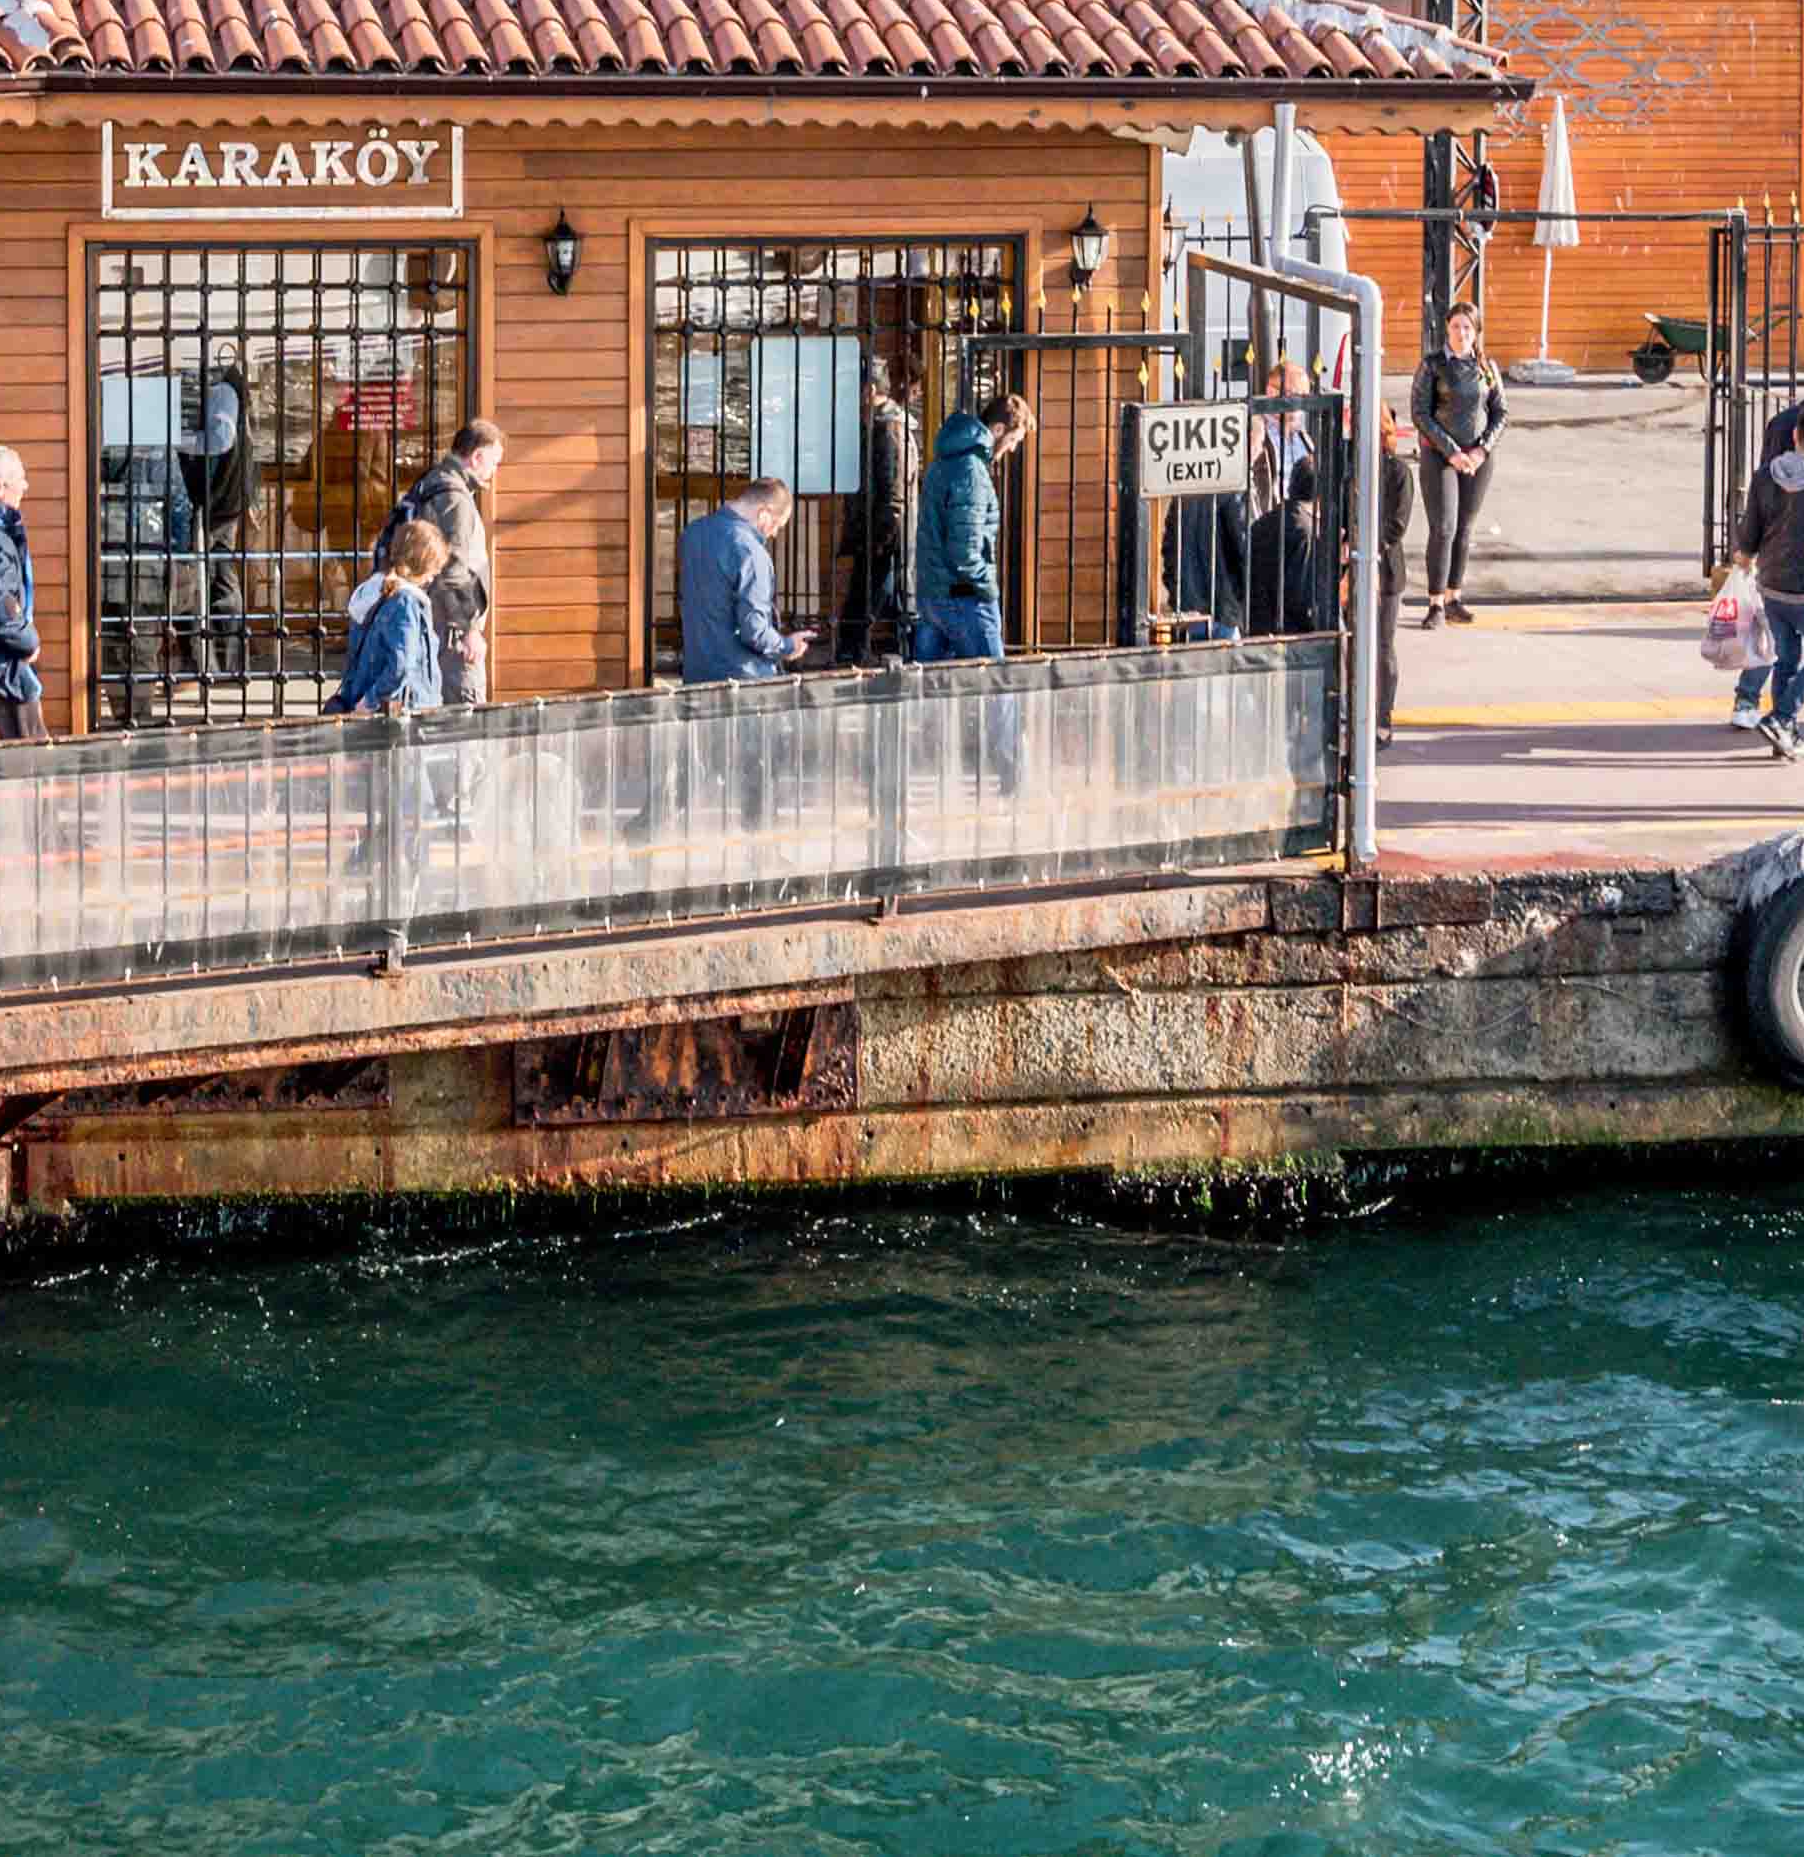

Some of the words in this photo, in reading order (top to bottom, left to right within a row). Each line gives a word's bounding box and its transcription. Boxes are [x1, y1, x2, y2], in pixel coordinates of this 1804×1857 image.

[123, 126, 440, 186] KARAKÖY
[1148, 415, 1241, 462] ÇIKIŞ
[1166, 457, 1222, 484] (EXIT)
